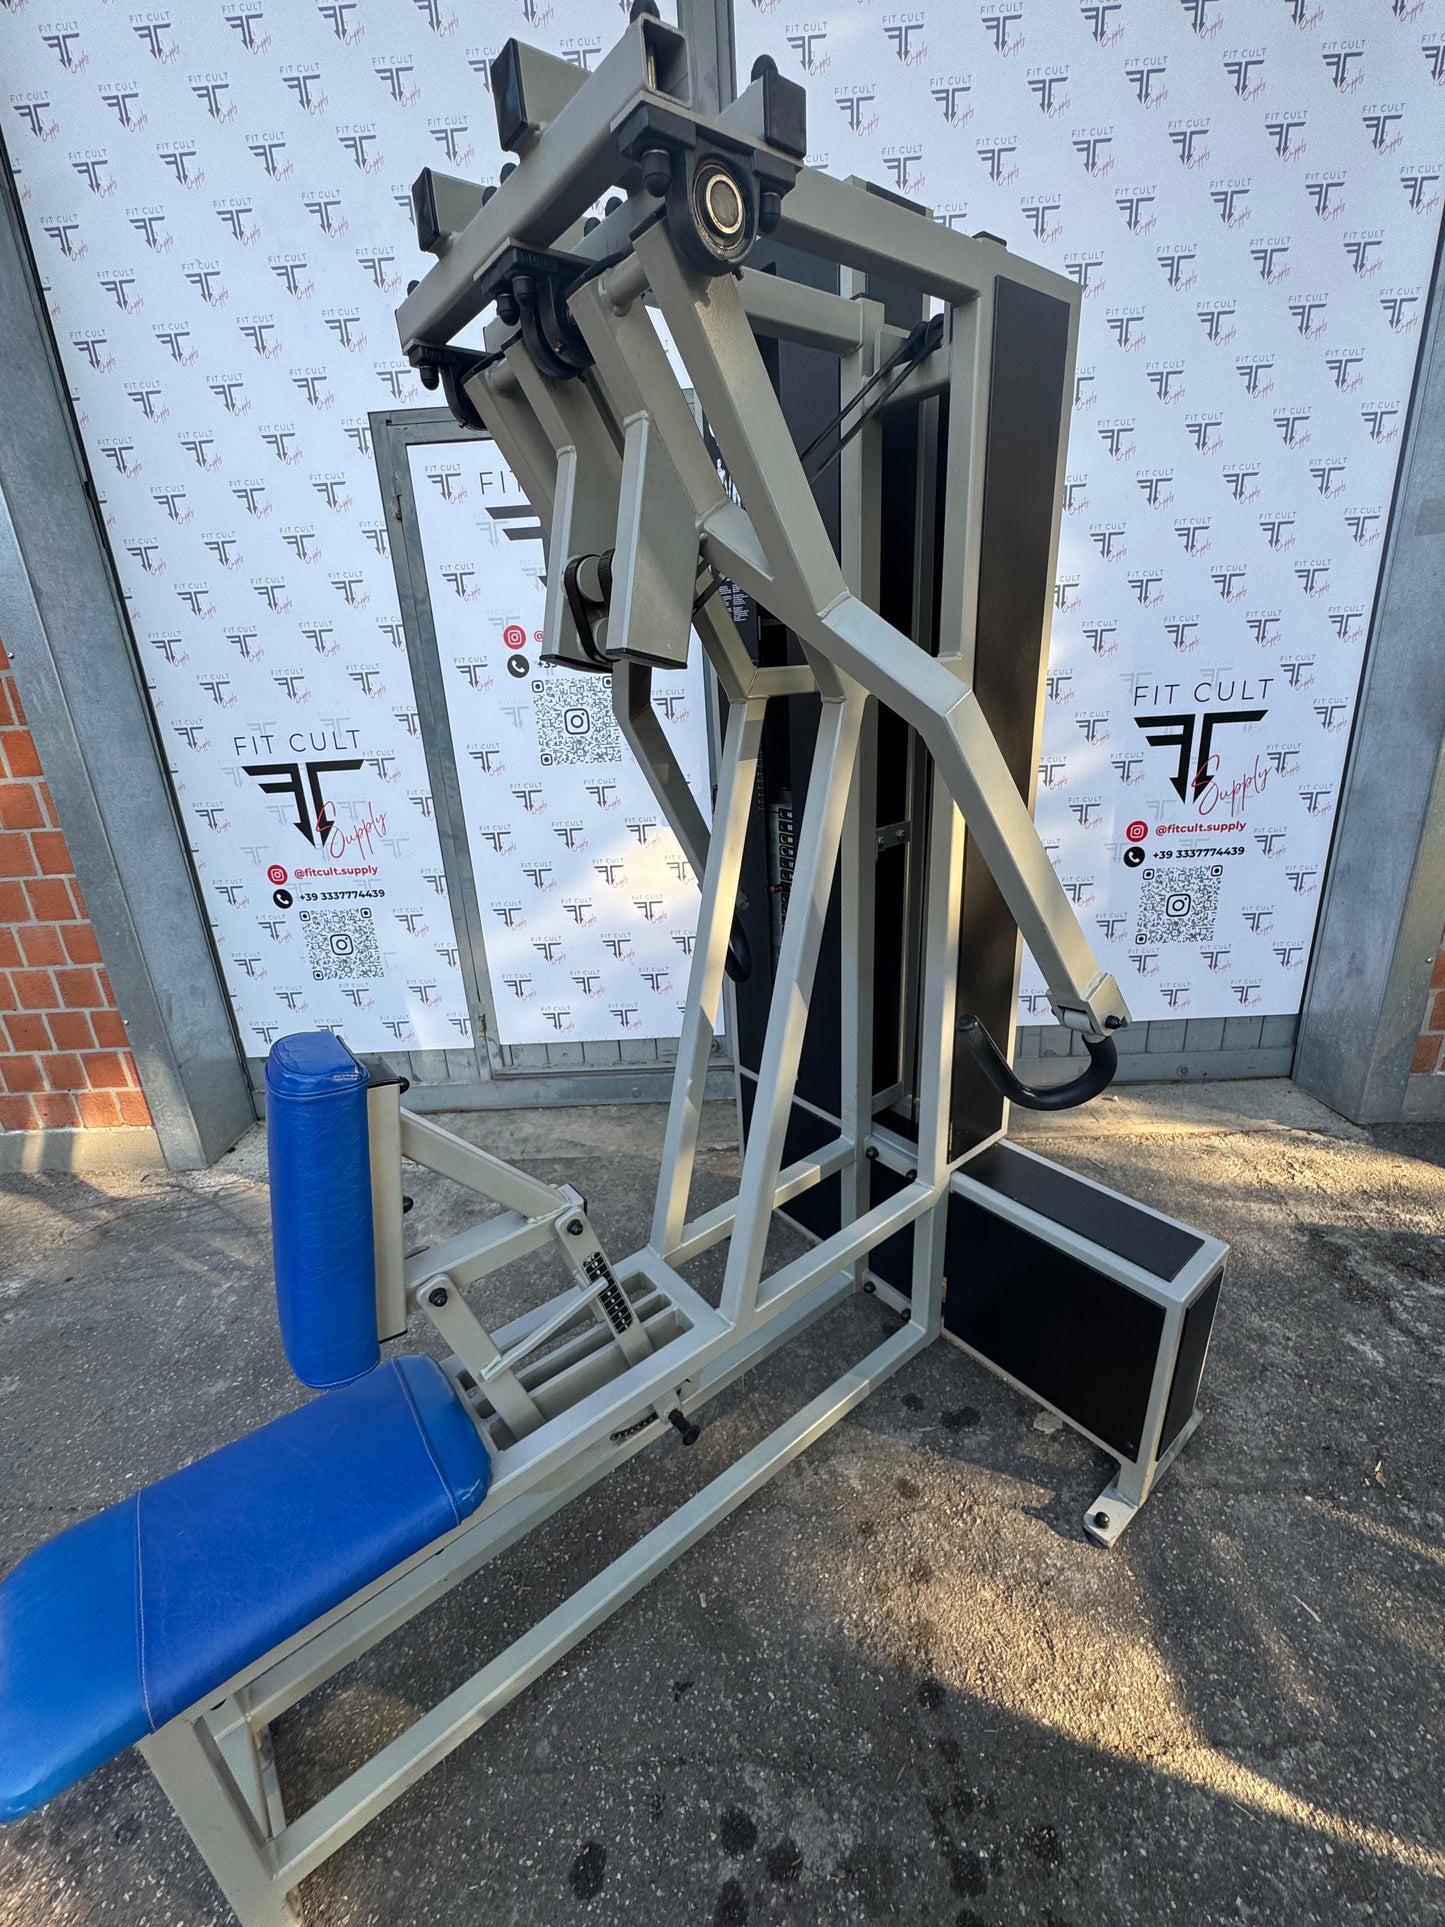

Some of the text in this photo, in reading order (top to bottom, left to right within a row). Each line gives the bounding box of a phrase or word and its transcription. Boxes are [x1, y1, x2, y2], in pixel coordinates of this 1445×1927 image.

[222, 1, 262, 13] FIT CULT
[980, 2, 1024, 15] FIT CULT
[882, 12, 925, 24] FIT CULT
[39, 21, 78, 33] FIT CULT
[1322, 39, 1366, 50] FIT CULT
[372, 54, 413, 66] FIT CULT
[1124, 56, 1168, 68] FIT CULT
[279, 62, 319, 75] FIT CULT
[98, 81, 137, 93] FIT CULT
[1362, 102, 1406, 114] FIT CULT
[427, 115, 468, 127] FIT CULT
[1265, 110, 1308, 121] FIT CULT
[335, 123, 376, 134] FIT CULT
[1072, 126, 1114, 138] FIT CULT
[245, 131, 285, 143] FIT CULT
[882, 144, 923, 156] FIT CULT
[1400, 164, 1443, 175] FIT CULT
[1210, 177, 1252, 189] FIT CULT
[301, 189, 340, 200] FIT CULT
[1020, 193, 1062, 205] FIT CULT
[40, 213, 77, 224] FIT CULT
[1343, 229, 1384, 240] FIT CULT
[1156, 243, 1198, 254] FIT CULT
[1288, 293, 1329, 303] FIT CULT
[322, 307, 359, 317] FIT CULT
[236, 314, 273, 325] FIT CULT
[290, 366, 326, 376] FIT CULT
[1146, 360, 1185, 370] FIT CULT
[1289, 406, 1312, 415] CULT
[424, 463, 460, 473] FIT CULT
[1152, 468, 1174, 477] CULT
[244, 478, 264, 486] CULT
[1274, 511, 1297, 520] CULT
[454, 563, 474, 571] CULT
[1309, 559, 1331, 567] CULT
[1261, 609, 1282, 617] CULT
[313, 620, 333, 628] CULT
[1134, 679, 1274, 706] FIT CULT
[234, 730, 360, 756] FIT CULT
[1191, 754, 1272, 817] Supply
[316, 801, 387, 860] Supply
[1156, 821, 1246, 836] @fitcult.supply
[1153, 846, 1245, 859] +39 3337774439
[294, 865, 378, 879] @fitcult.supply
[300, 889, 385, 901] +39 3337774439
